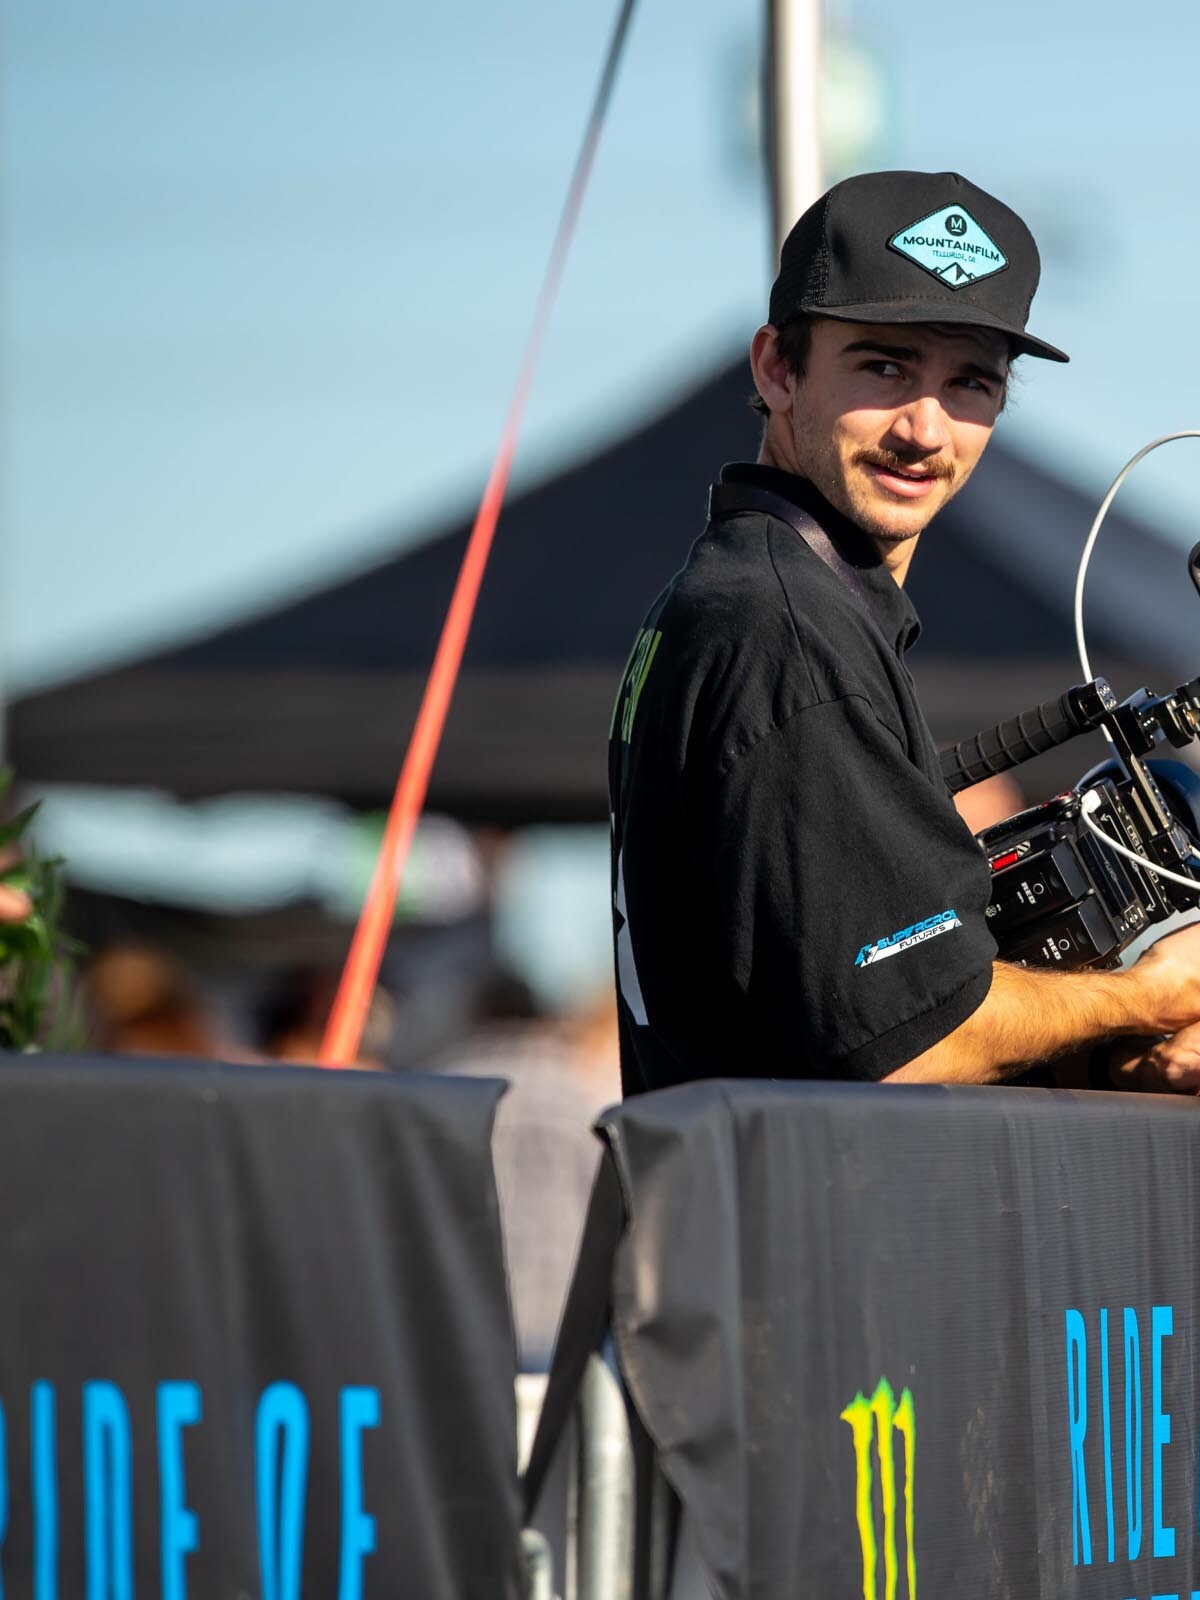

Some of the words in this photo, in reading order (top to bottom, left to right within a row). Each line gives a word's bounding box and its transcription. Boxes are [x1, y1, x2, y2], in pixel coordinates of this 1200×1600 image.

[950, 216, 963, 229] M
[903, 236, 1000, 262] MOUNTAINFILM
[1021, 881, 1037, 905] RED
[899, 924, 946, 950] FUTURES
[1046, 937, 1062, 960] RED
[1064, 1304, 1176, 1566] RIDE
[254, 1380, 381, 1600] OF
